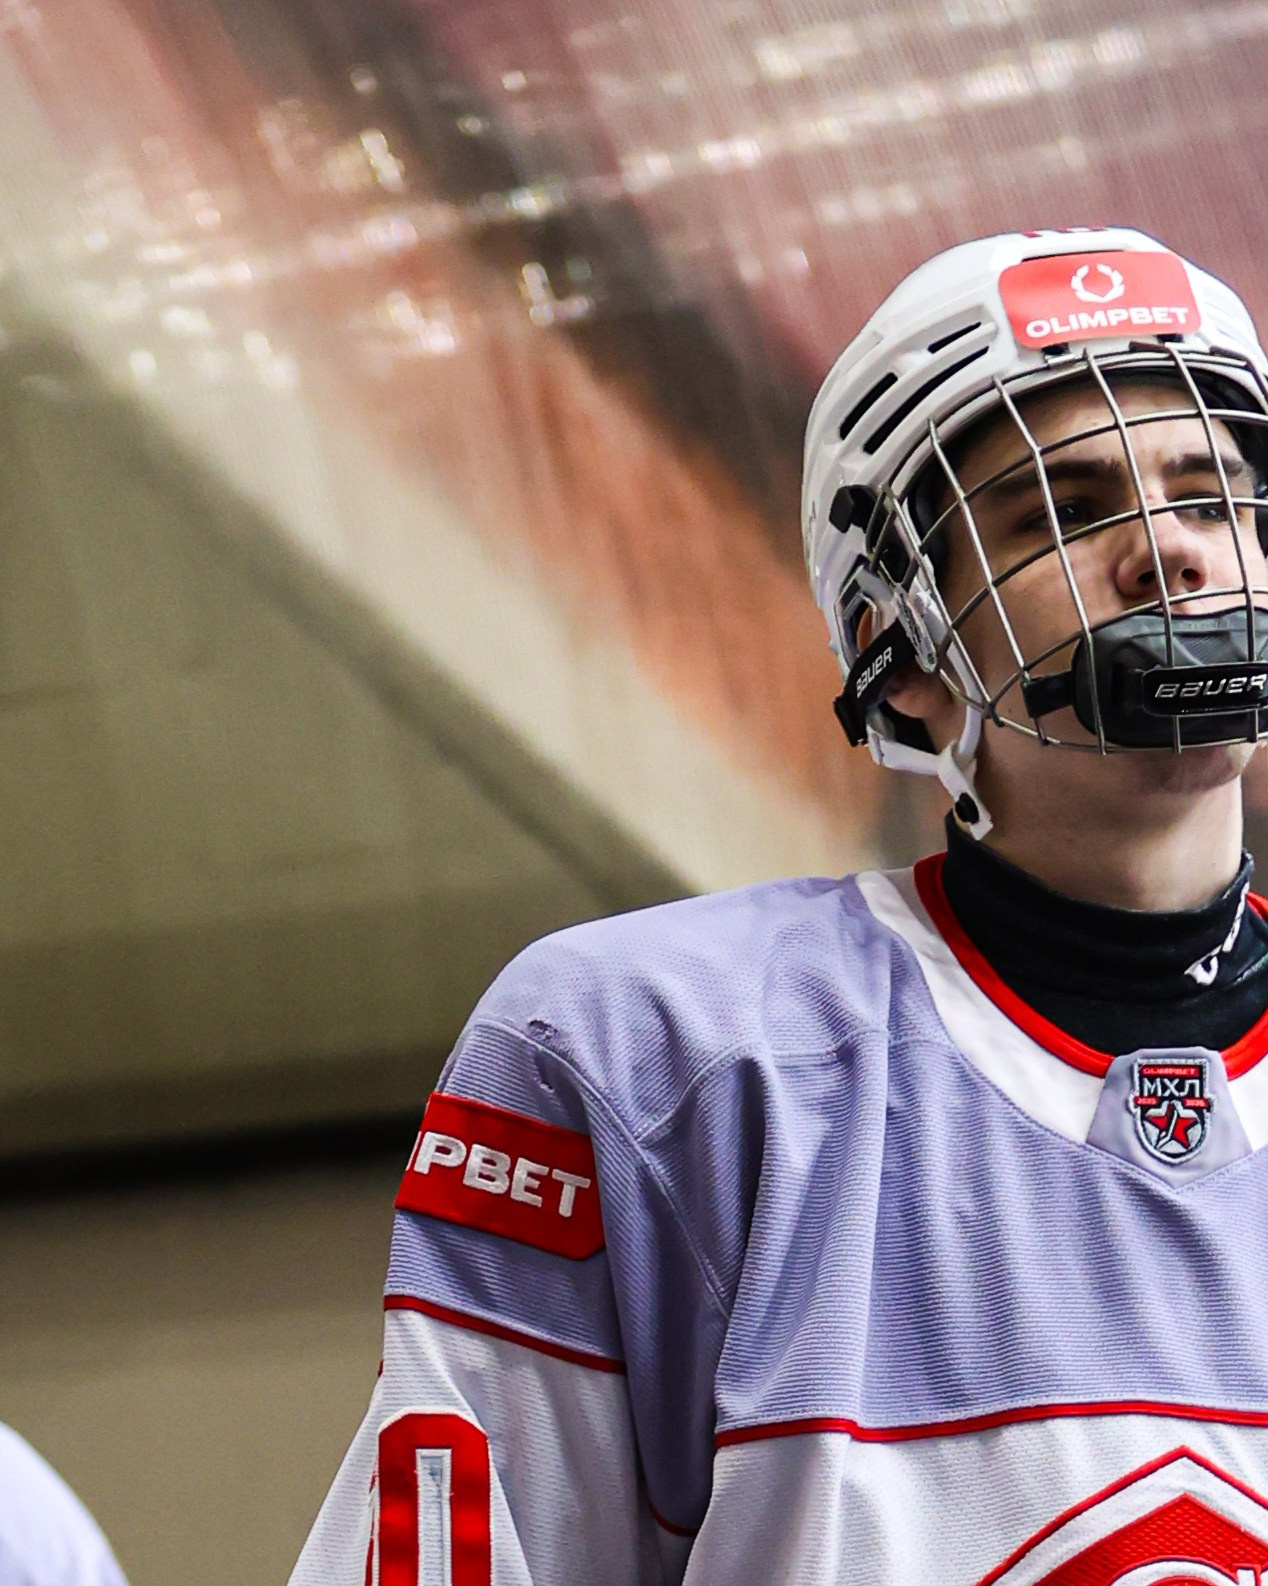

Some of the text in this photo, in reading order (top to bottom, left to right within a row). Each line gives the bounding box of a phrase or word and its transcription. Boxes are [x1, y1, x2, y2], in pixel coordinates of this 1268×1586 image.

[1025, 305, 1189, 339] OLIMPBET
[855, 645, 893, 699] BAUER
[1154, 673, 1267, 698] BAUER
[1142, 1077, 1200, 1098] МХЛ
[407, 1130, 591, 1218] PBET
